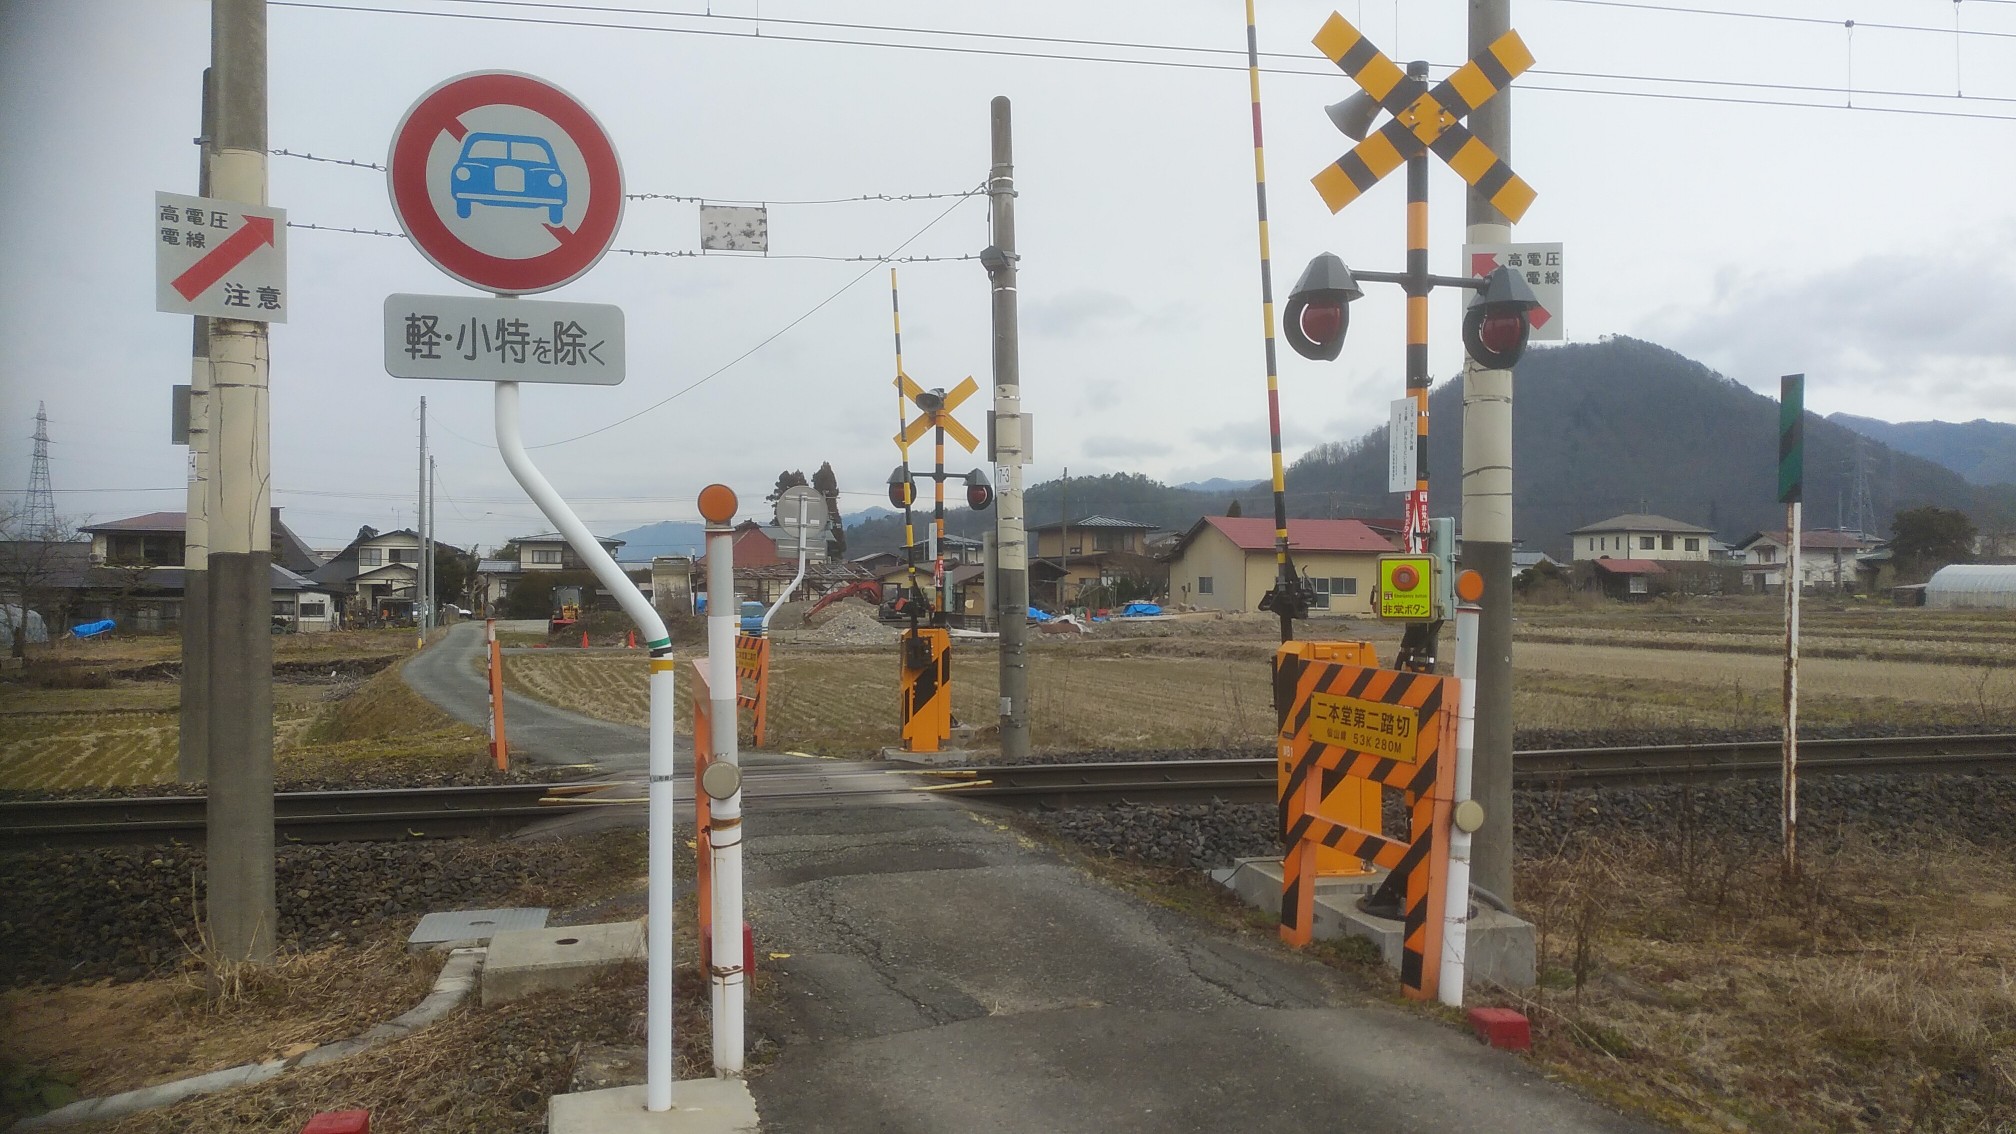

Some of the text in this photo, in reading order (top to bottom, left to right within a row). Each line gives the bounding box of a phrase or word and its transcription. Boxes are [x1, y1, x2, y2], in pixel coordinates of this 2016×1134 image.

[160, 204, 228, 229] 高電圧
[161, 227, 206, 248] 電線
[1507, 252, 1560, 267] 高電圧
[1526, 271, 1560, 285] 電線
[224, 282, 281, 310] 注意
[404, 312, 605, 366] 軽・小特を除く
[1383, 604, 1429, 615] 非常ボタン
[1316, 701, 1411, 738] 二本堂第二踏切
[1353, 732, 1373, 748] 53K
[1374, 737, 1402, 754] 280M
